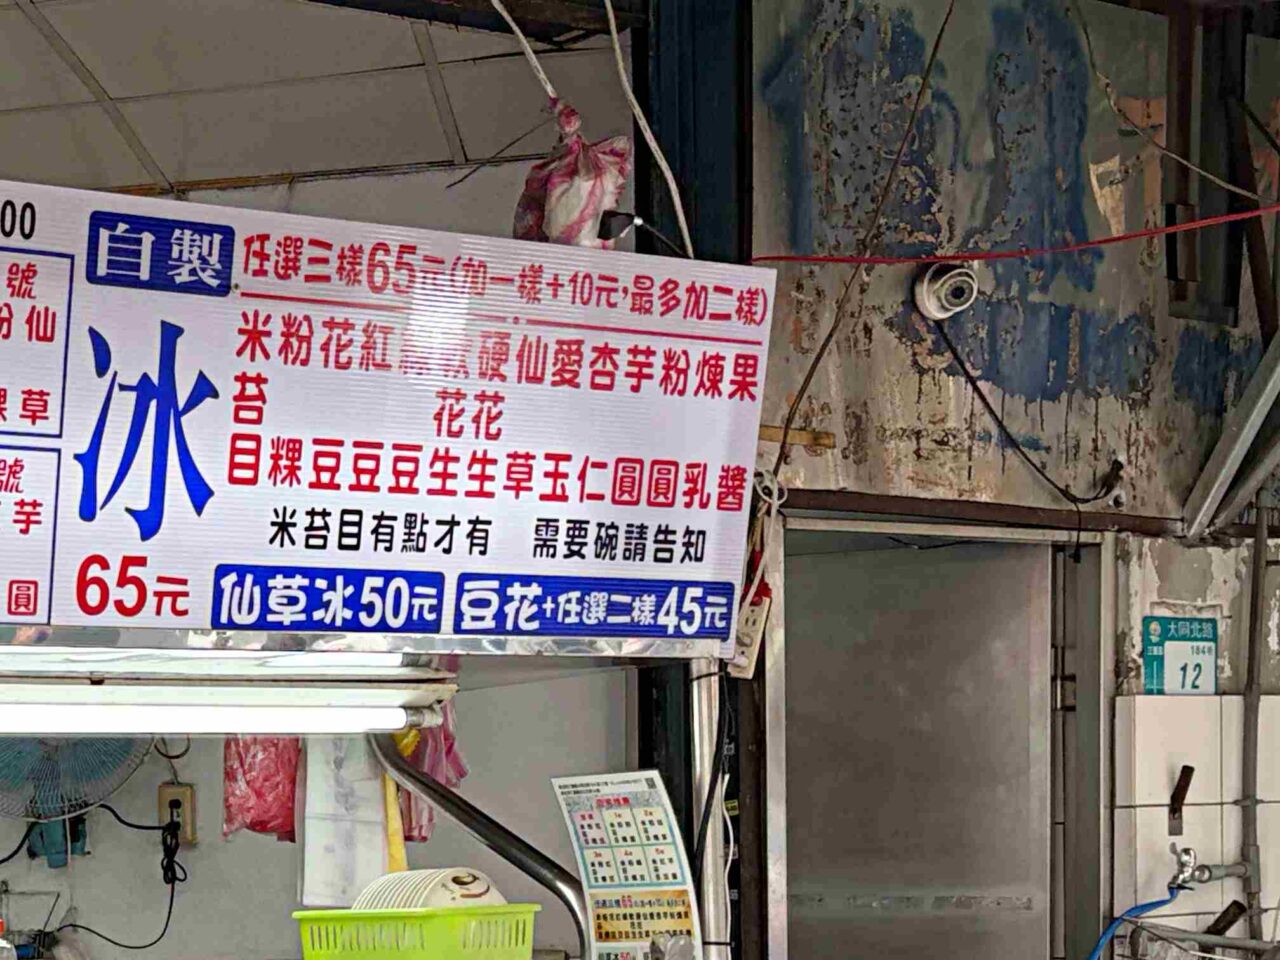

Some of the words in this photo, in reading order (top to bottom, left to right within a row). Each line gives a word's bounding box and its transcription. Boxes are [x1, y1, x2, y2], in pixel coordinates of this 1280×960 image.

[96, 223, 223, 288] 自製
[73, 320, 220, 543] 冰
[268, 506, 493, 556] 米苔目有點才有
[532, 517, 707, 564] 需要碗請告知
[76, 554, 190, 618] 65元
[219, 571, 438, 629] 仙草冰50元
[460, 580, 729, 636] 豆花+任選二樣45元
[1179, 662, 1203, 690] 12
